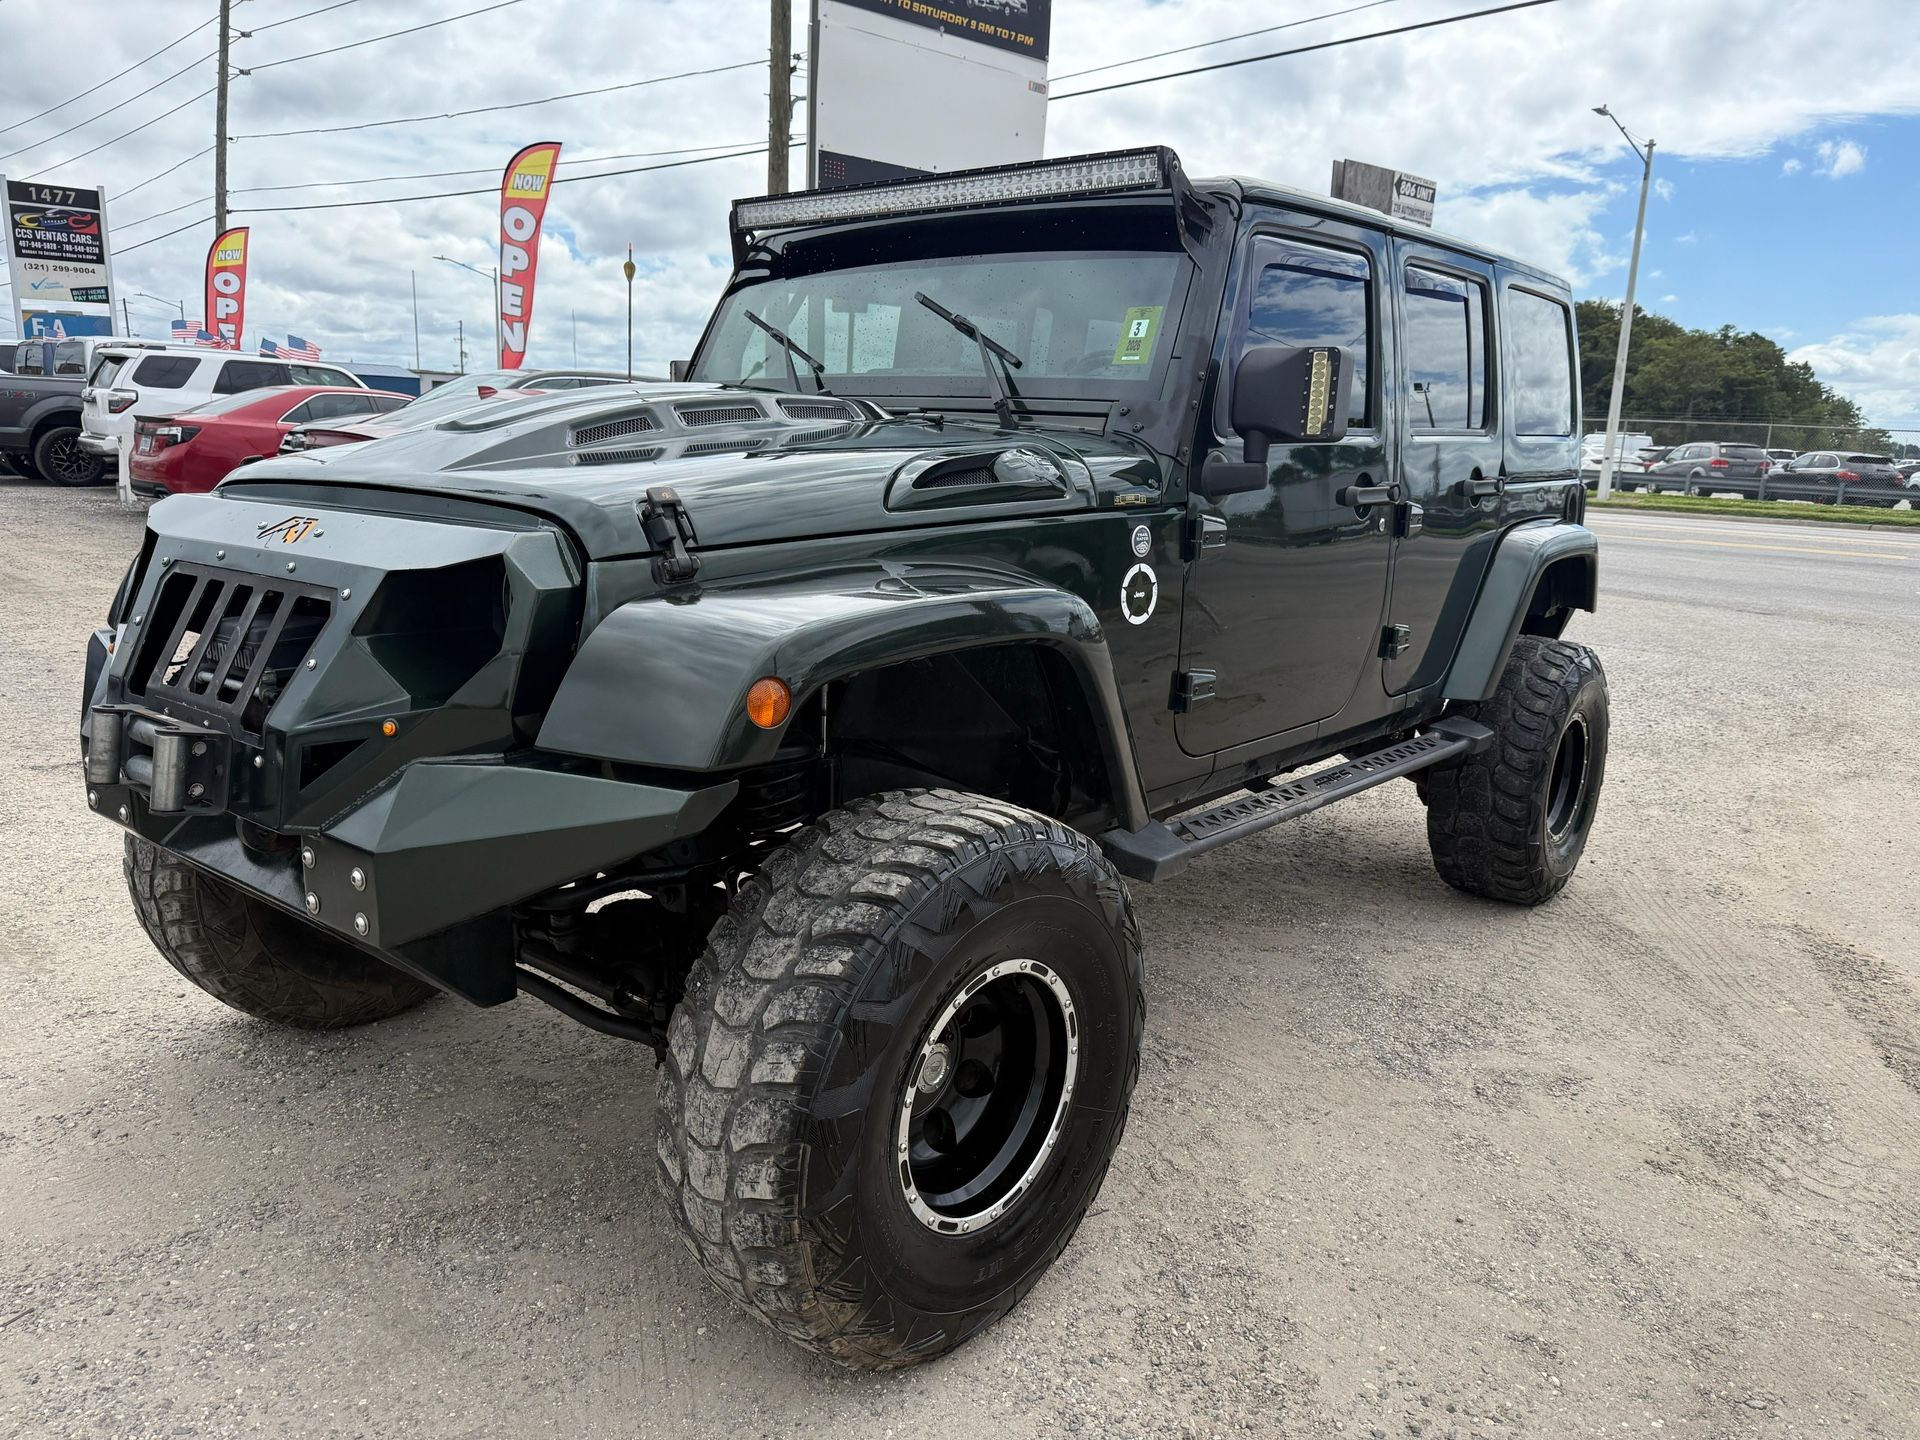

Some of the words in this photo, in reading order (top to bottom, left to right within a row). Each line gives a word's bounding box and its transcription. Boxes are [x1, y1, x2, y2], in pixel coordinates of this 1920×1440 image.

[896, 0, 912, 10] TO
[912, 2, 969, 26] SATURDAY
[970, 20, 977, 29] 9
[977, 22, 995, 35] AM
[996, 27, 1010, 39] TO
[1010, 31, 1016, 40] 7
[1016, 33, 1035, 46] PM
[512, 173, 545, 192] NOW
[1400, 180, 1416, 197] 806
[1416, 186, 1434, 202] UNIT
[28, 186, 76, 206] 1477
[15, 228, 33, 239] CCS
[34, 230, 68, 242] VENTAS
[70, 234, 92, 245] CARS
[218, 249, 242, 262] NOW
[24, 262, 49, 272] (321)
[52, 265, 96, 274] 299-9004
[502, 206, 537, 353] OPEN
[213, 271, 241, 346] OPE
[1134, 322, 1142, 337] 3
